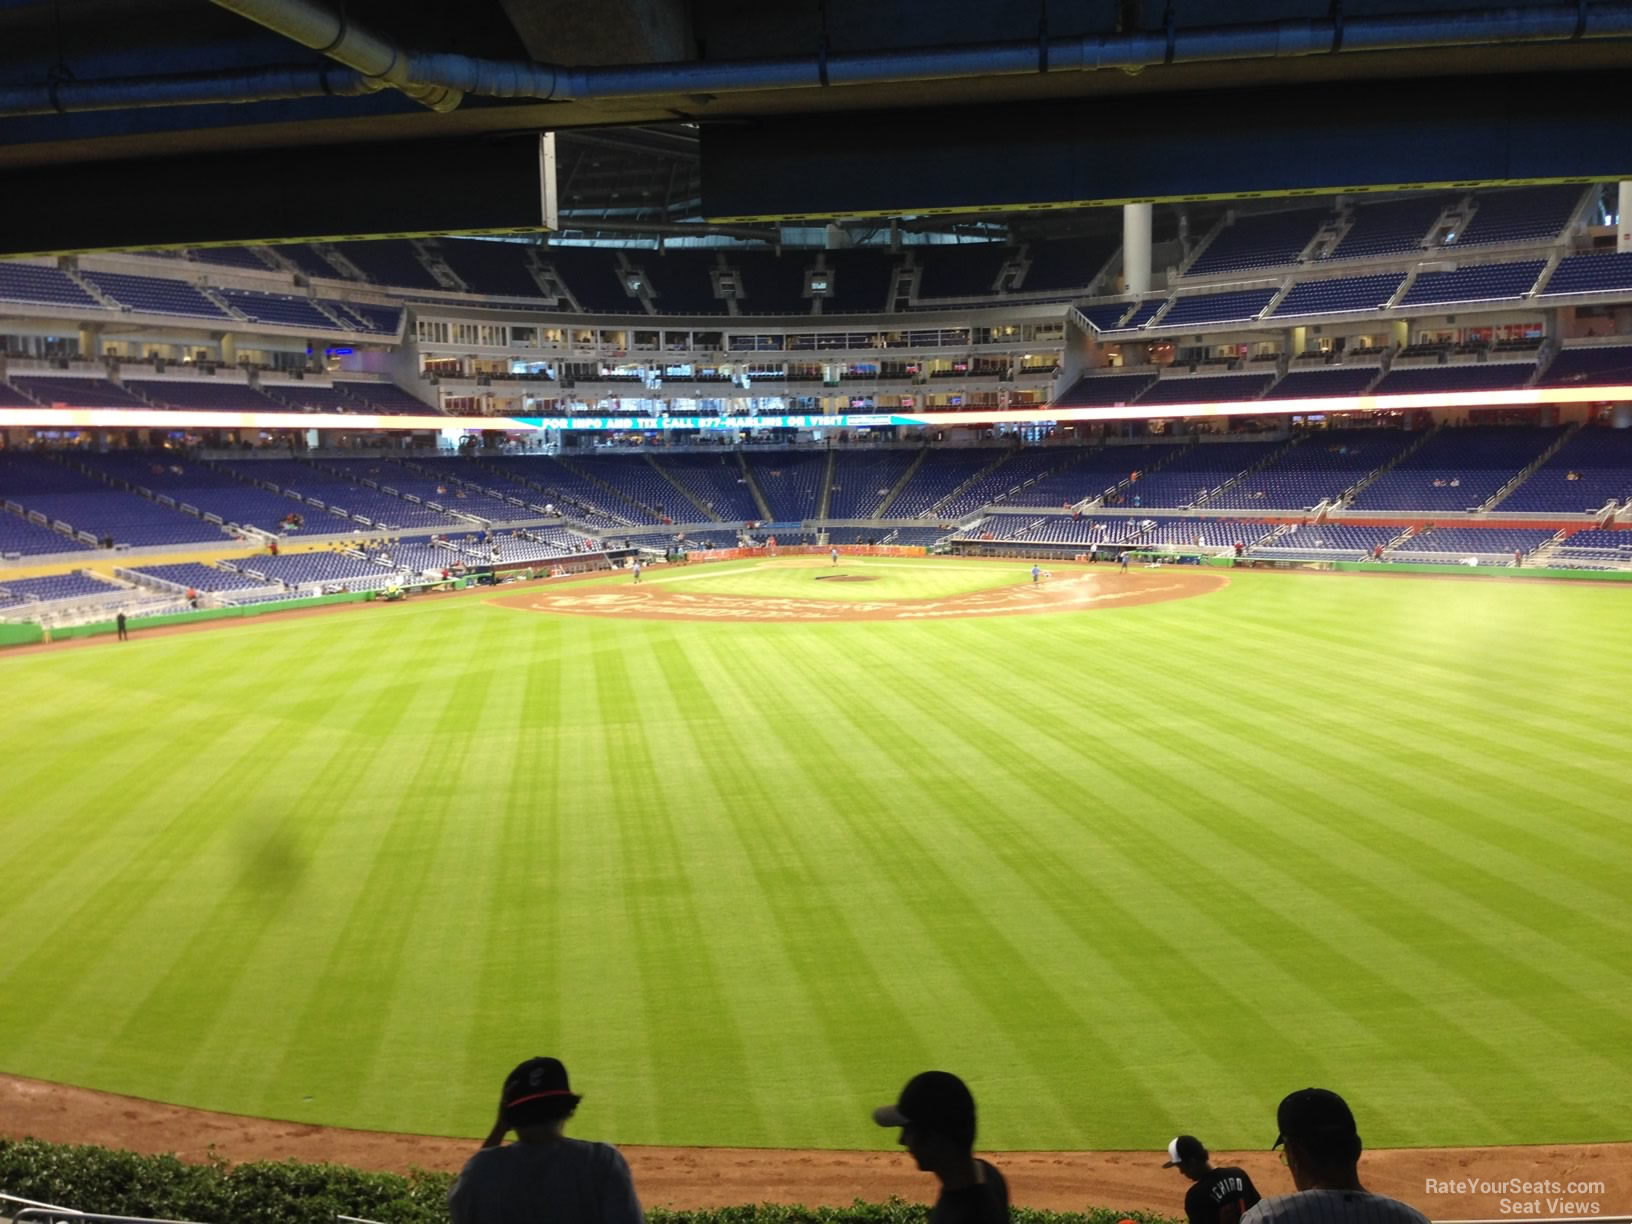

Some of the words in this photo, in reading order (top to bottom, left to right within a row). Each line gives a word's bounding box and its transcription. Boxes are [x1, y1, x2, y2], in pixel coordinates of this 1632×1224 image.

[543, 417, 568, 429] FOR
[662, 416, 694, 429] CALL
[1209, 1177, 1243, 1203] ICHIRO
